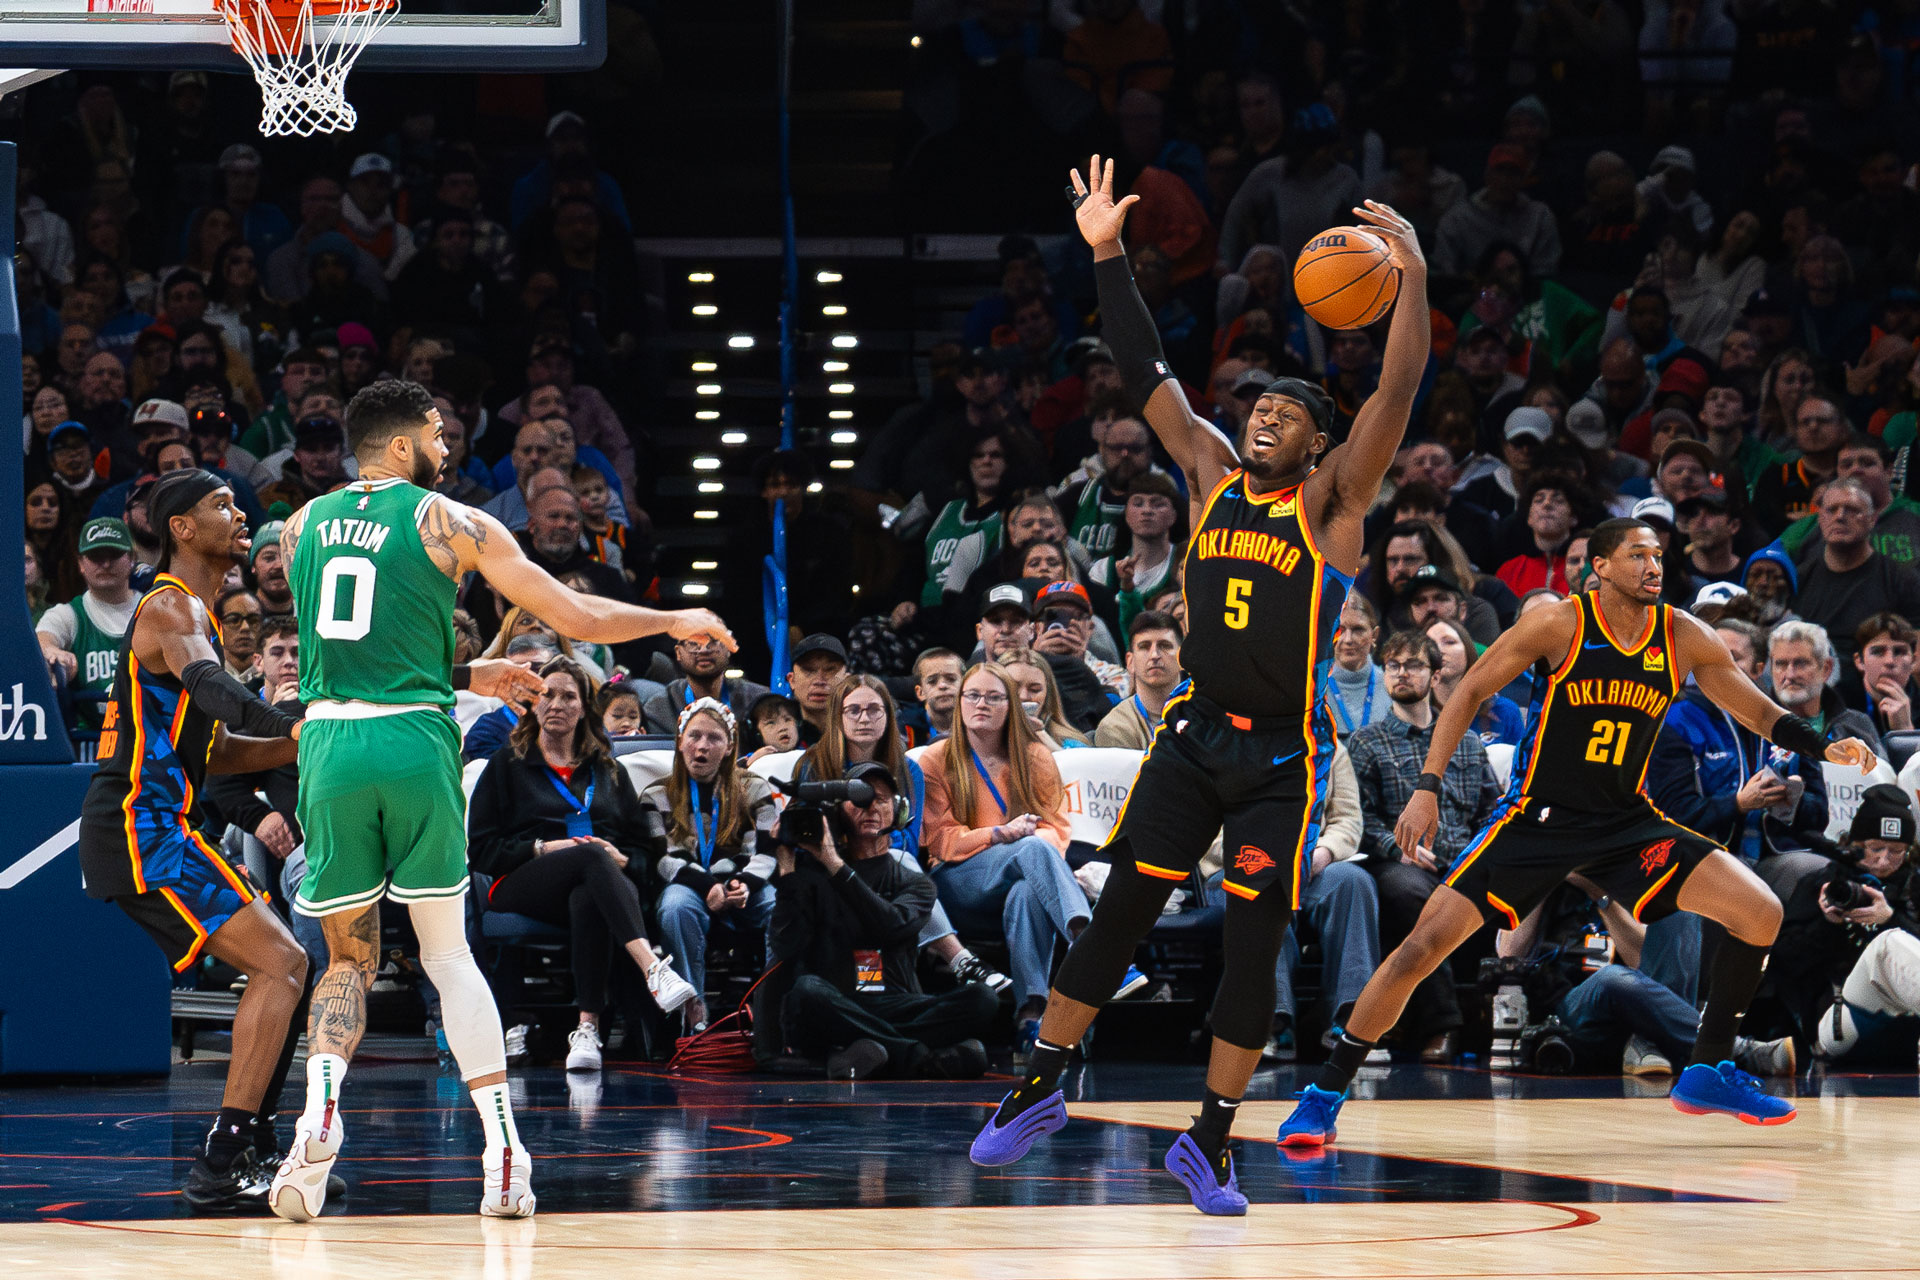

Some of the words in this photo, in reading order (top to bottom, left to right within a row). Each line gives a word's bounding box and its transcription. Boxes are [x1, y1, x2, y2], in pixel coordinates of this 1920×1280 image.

[316, 518, 391, 553] TATUM
[1198, 527, 1302, 577] OKLAHOMA
[315, 556, 377, 641] 0
[1224, 577, 1253, 630] 5
[1566, 678, 1668, 719] OKLAHOMA
[1585, 719, 1632, 766] 21
